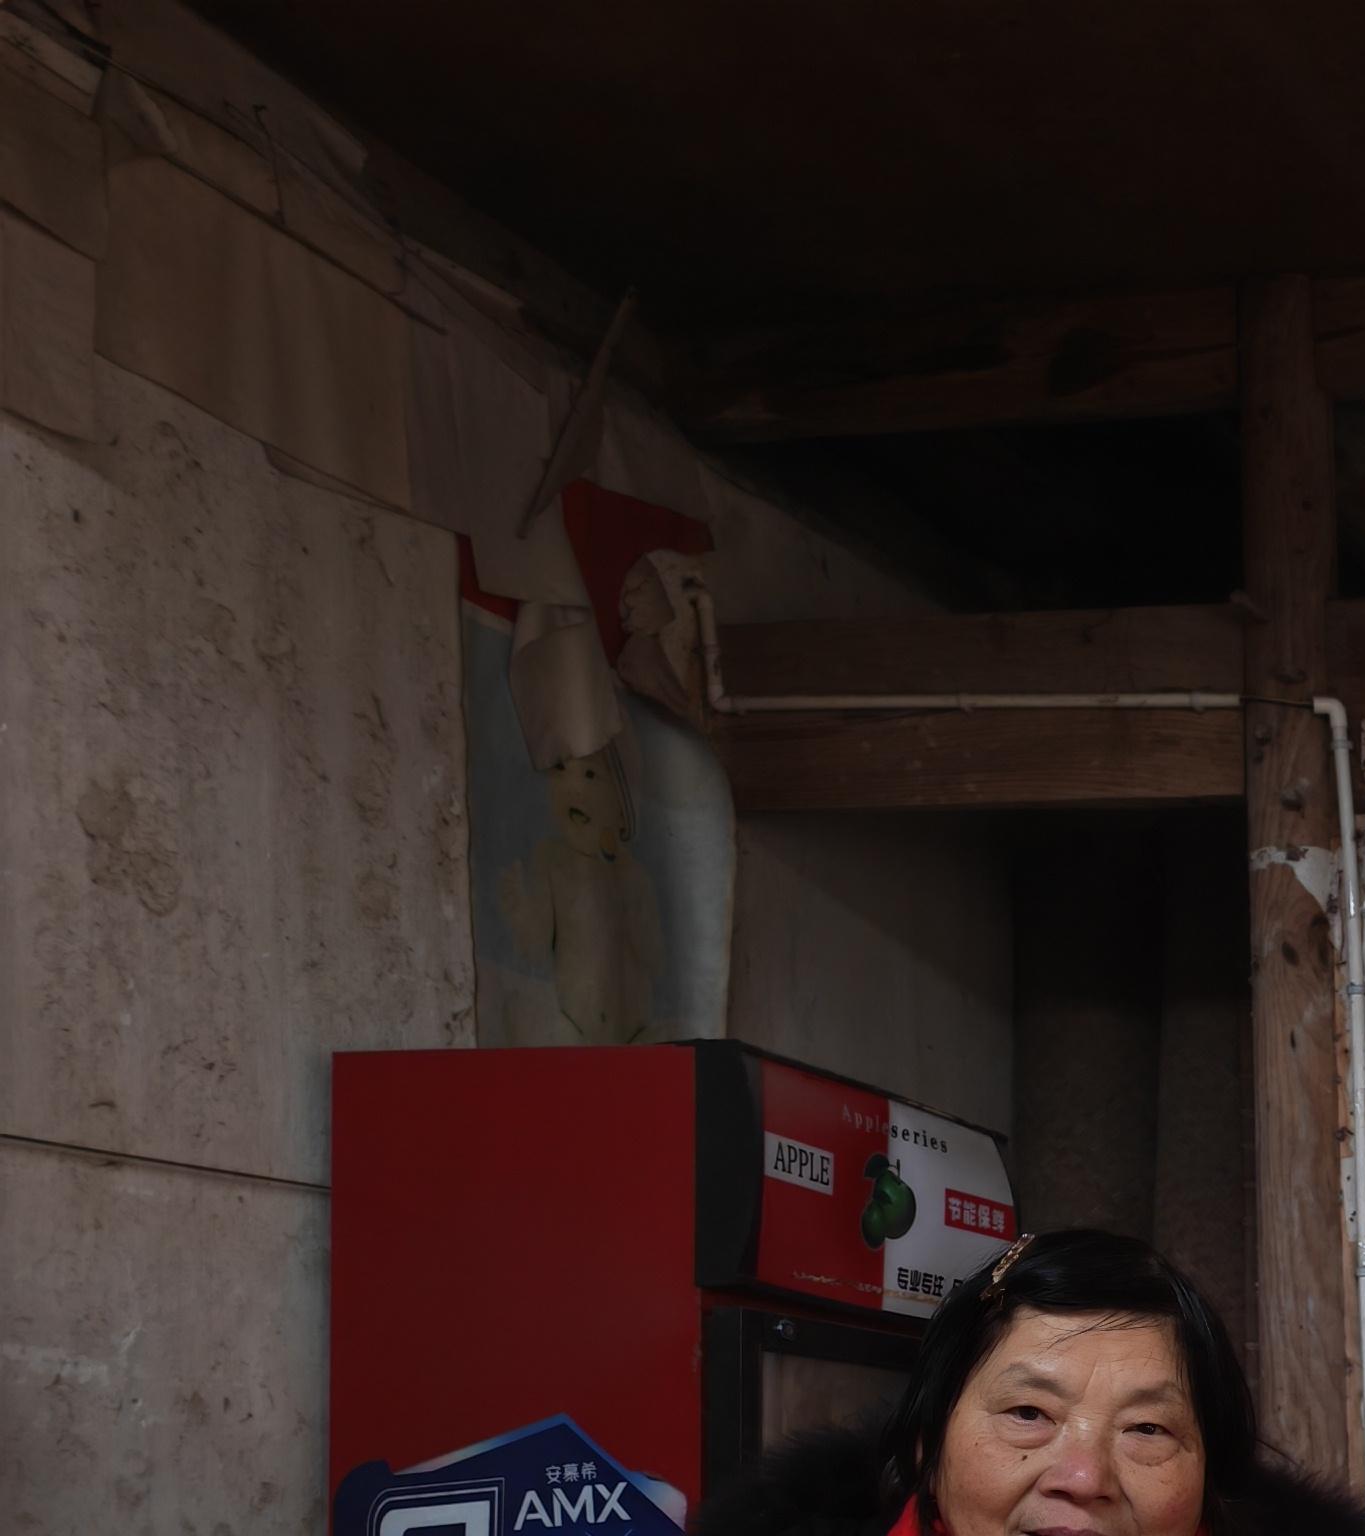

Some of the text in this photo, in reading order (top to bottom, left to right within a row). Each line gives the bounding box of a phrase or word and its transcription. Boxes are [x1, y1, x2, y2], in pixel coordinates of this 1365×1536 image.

[842, 1103, 949, 1154] Apple series
[773, 1141, 831, 1187] APPLE
[545, 1460, 598, 1484] 安慕希
[513, 1481, 633, 1532] AMX
